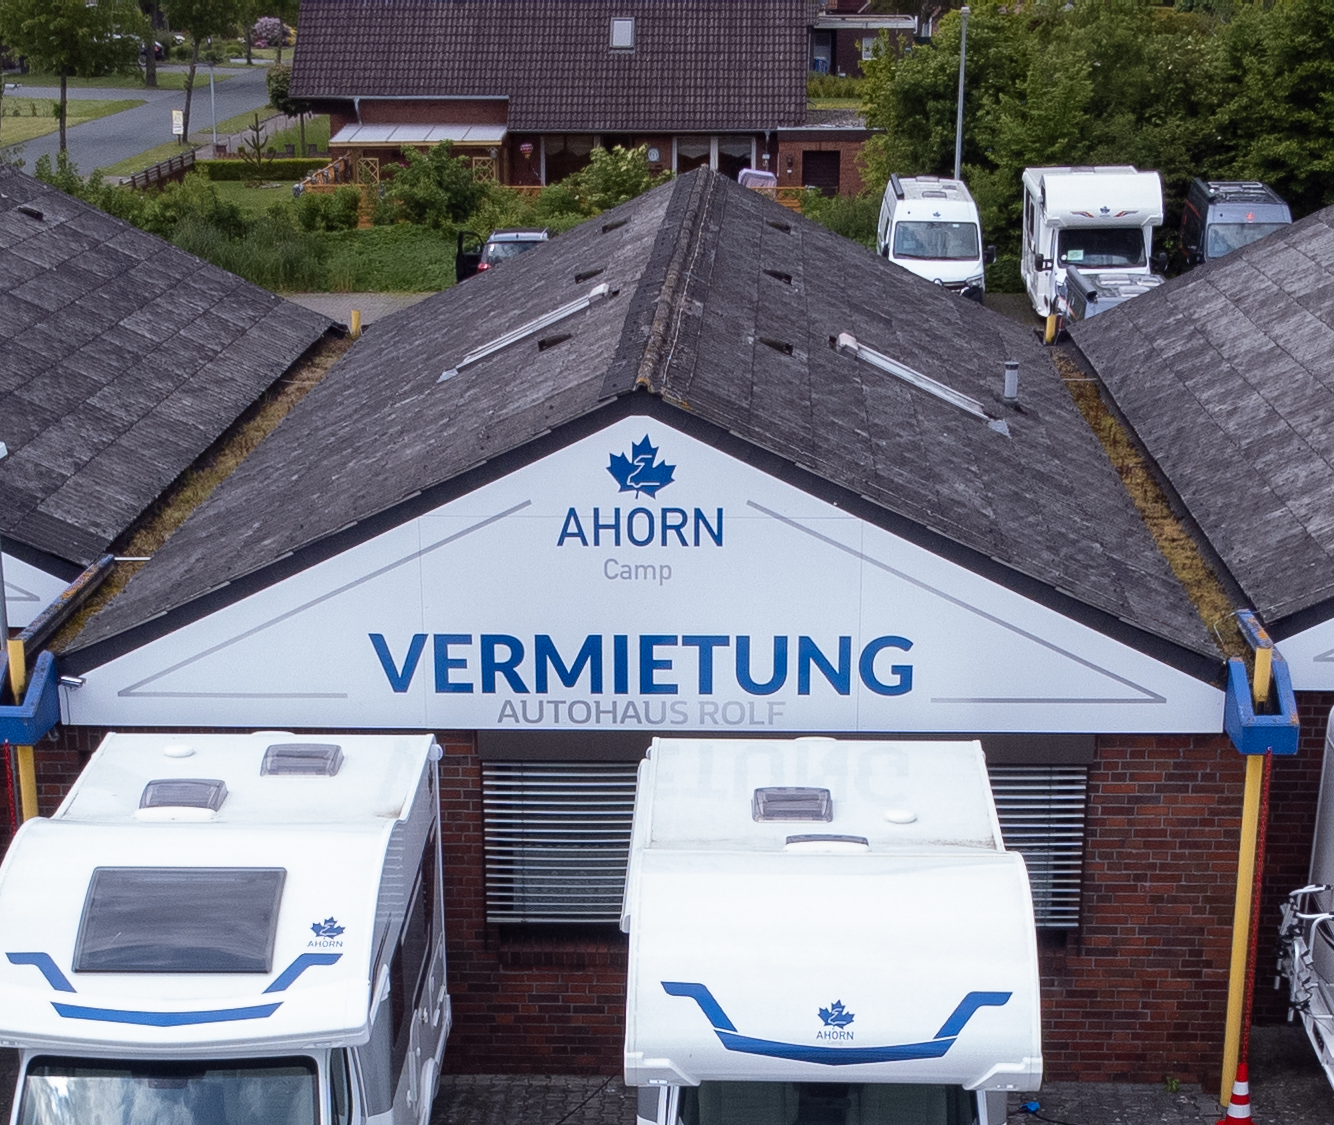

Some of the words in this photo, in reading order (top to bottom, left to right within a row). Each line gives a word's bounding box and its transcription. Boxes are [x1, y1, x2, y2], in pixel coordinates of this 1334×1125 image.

[556, 507, 724, 548] AHORN
[603, 558, 673, 586] Camp
[368, 632, 915, 696] VERMIETUNG
[497, 700, 689, 725] AUTOHAUS
[698, 701, 786, 726] ROLF
[307, 940, 344, 948] AHORN
[816, 1030, 855, 1041] AHORN
